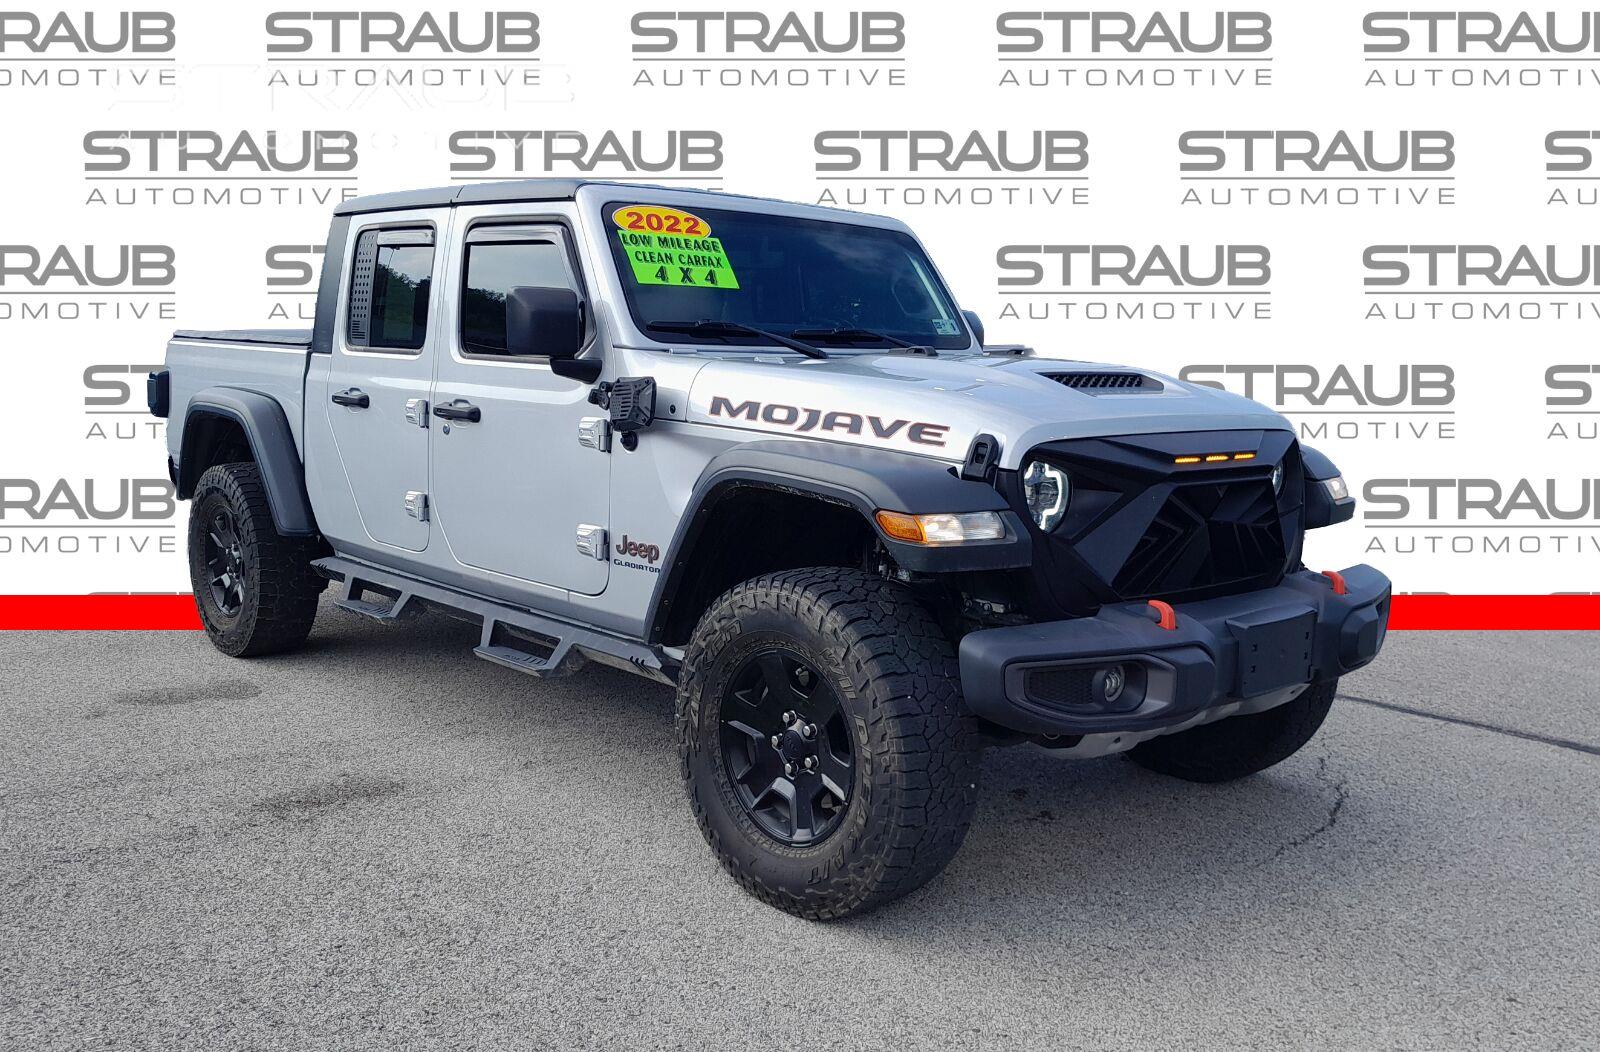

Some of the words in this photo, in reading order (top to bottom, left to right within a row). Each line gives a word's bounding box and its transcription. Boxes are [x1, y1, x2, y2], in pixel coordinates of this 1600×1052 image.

[266, 11, 540, 53] STRAUB
[631, 11, 905, 53] STRAUB
[996, 11, 1272, 53] STRAUB
[1363, 11, 1600, 53] STRAU
[268, 69, 540, 86] AUTOMOTIVE
[633, 69, 905, 86] AUTOMOTIVE
[999, 69, 1272, 86] AUTOMOTIVE
[83, 130, 358, 172] STRAUB
[449, 130, 723, 172] STRAUB
[814, 130, 1089, 172] STRAUB
[1179, 130, 1455, 172] STRAUB
[86, 188, 358, 205] AUTOMOTIVE
[817, 188, 1089, 205] AUTOMOTIVE
[1181, 188, 1455, 205] AUTOMOTIVE
[626, 211, 702, 235] 2022
[620, 233, 652, 247] LOW
[657, 236, 722, 253] MILEAGE
[634, 251, 674, 265] CLEAN
[678, 254, 724, 268] CARFAX
[997, 244, 1272, 286] STRAUB
[1363, 244, 1600, 286] STRAU
[655, 265, 668, 283] 4
[705, 269, 718, 286] 4
[999, 303, 1272, 319] AUTOMOTIVE
[1179, 364, 1455, 406] STRAUB
[709, 396, 950, 447] MOJAVE
[1301, 422, 1455, 439] MOTIVE
[1363, 478, 1600, 520] STRAU
[616, 534, 660, 564] Jeep
[613, 558, 660, 573] GLADIATOR
